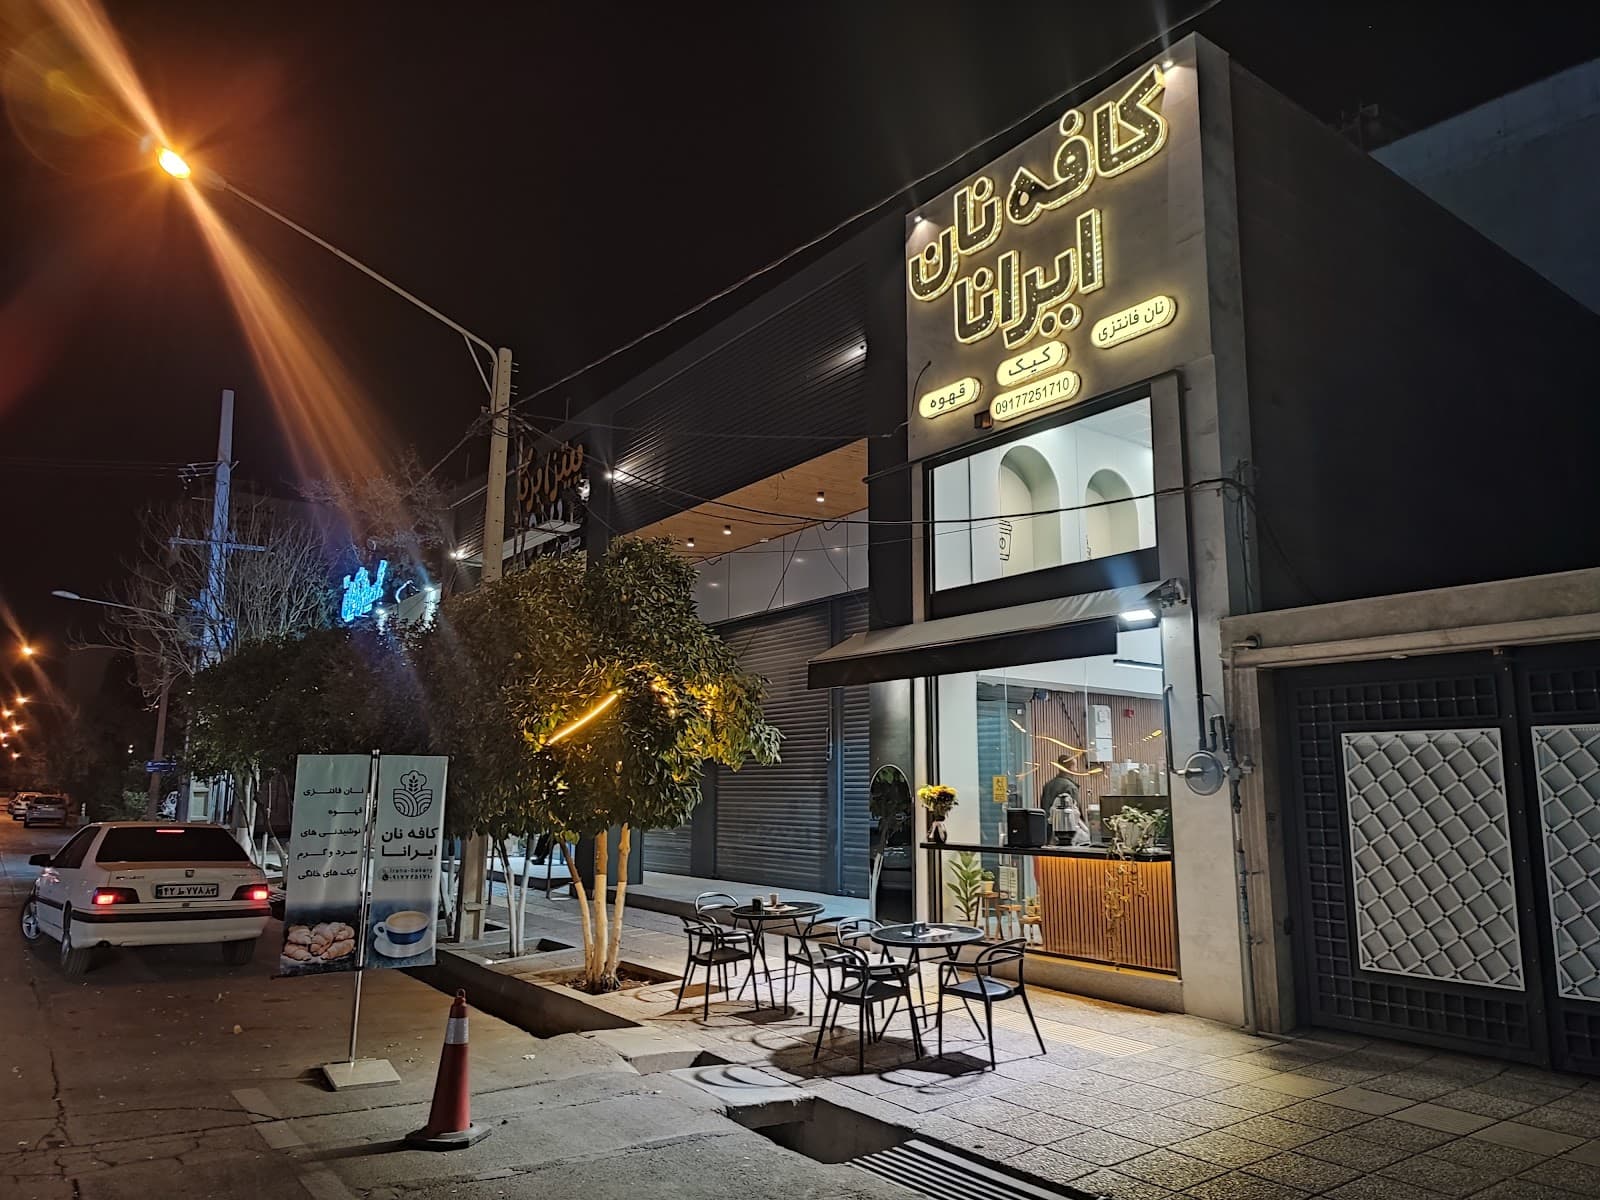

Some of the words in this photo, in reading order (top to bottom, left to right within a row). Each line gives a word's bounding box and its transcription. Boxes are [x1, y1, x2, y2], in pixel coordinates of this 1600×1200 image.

[1006, 64, 1167, 225] کافه
[908, 176, 1002, 302] نان
[954, 208, 1103, 350] ایرانا
[1144, 301, 1165, 323] نان
[1098, 309, 1140, 341] فانتزی
[1008, 347, 1051, 377] کیک
[930, 383, 966, 409] قهوه
[994, 377, 1070, 415] 09177251710
[300, 828, 317, 838] های
[381, 827, 403, 843] نان
[407, 826, 439, 839] کافه
[335, 848, 358, 857] سرد
[381, 844, 438, 861] ایرانا
[322, 868, 338, 878] های
[340, 867, 359, 877] کیک
